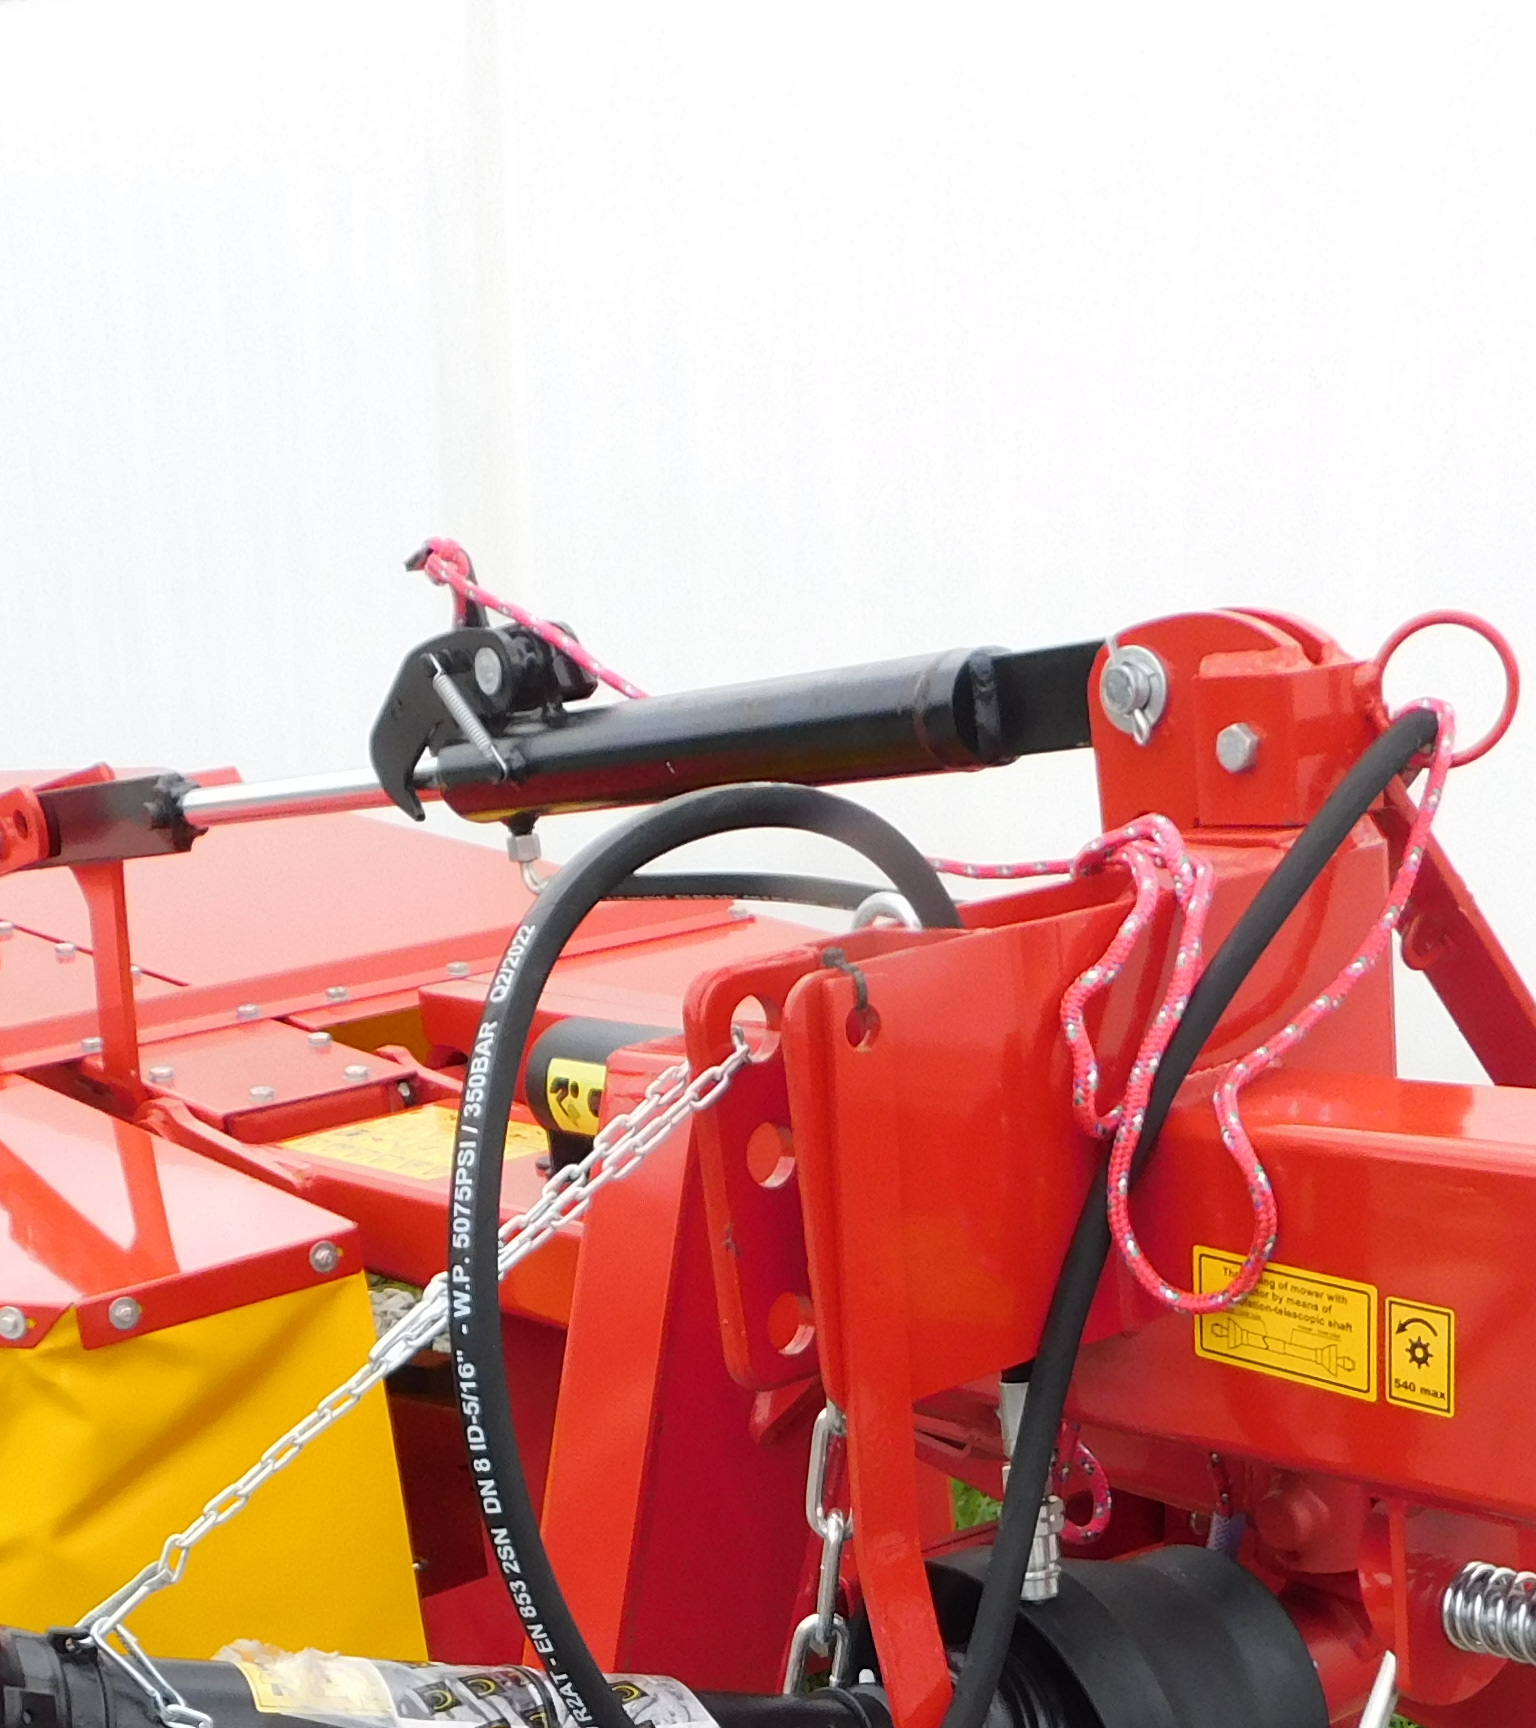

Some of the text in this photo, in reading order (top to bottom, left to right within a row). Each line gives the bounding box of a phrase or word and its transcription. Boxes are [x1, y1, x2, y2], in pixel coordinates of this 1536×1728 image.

[490, 924, 536, 1003] Q2/2022
[464, 1020, 498, 1118] 350BAR
[452, 1141, 477, 1249] 5075PSI
[452, 1257, 472, 1318] W.P.
[1272, 1291, 1284, 1304] by
[1286, 1296, 1319, 1312] means
[1290, 1283, 1324, 1299] mower
[1327, 1292, 1348, 1306] with
[1327, 1319, 1352, 1333] shaft
[456, 1350, 487, 1451] ID-5/16"
[1394, 1378, 1446, 1400] 540 max
[473, 1458, 491, 1472] 8
[477, 1479, 502, 1514] DN
[491, 1528, 521, 1574] 2SN
[509, 1580, 537, 1618] 853
[526, 1623, 555, 1653] EN
[550, 1671, 594, 1722] R2AT
